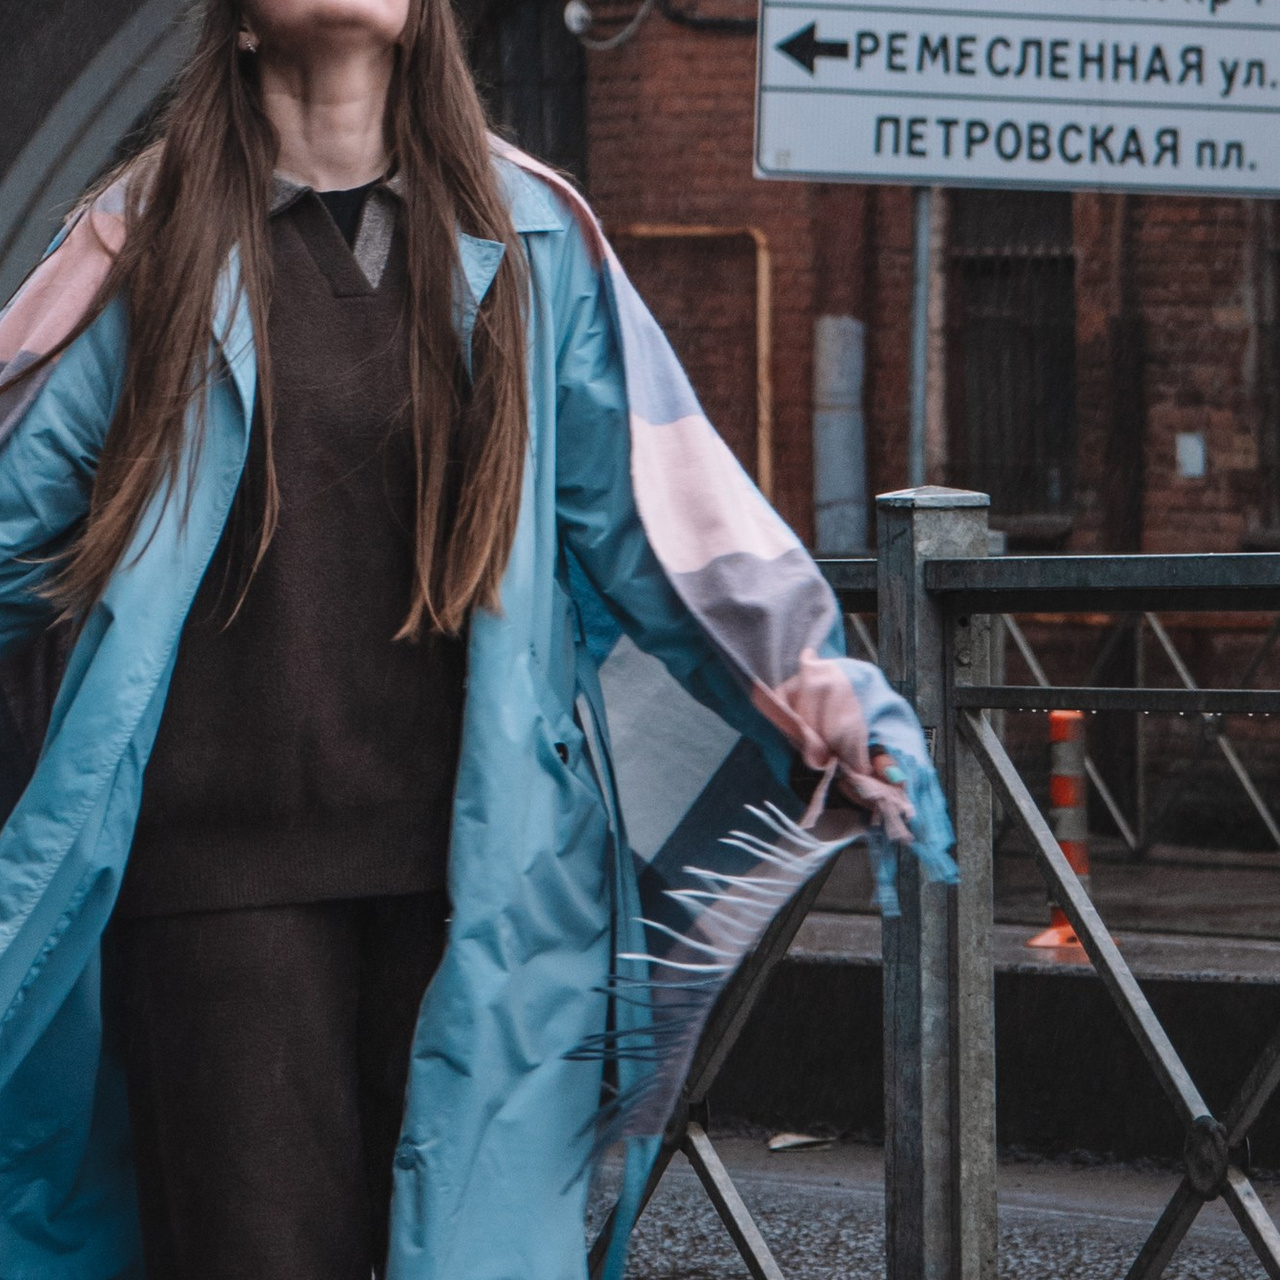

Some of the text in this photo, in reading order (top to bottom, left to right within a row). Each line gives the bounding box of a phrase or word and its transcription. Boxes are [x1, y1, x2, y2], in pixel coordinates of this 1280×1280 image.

[855, 30, 1278, 98] РЕМЕСЛЕННАЯ ул.
[874, 114, 1257, 171] ПЕТРОВСКАЯ пл.
